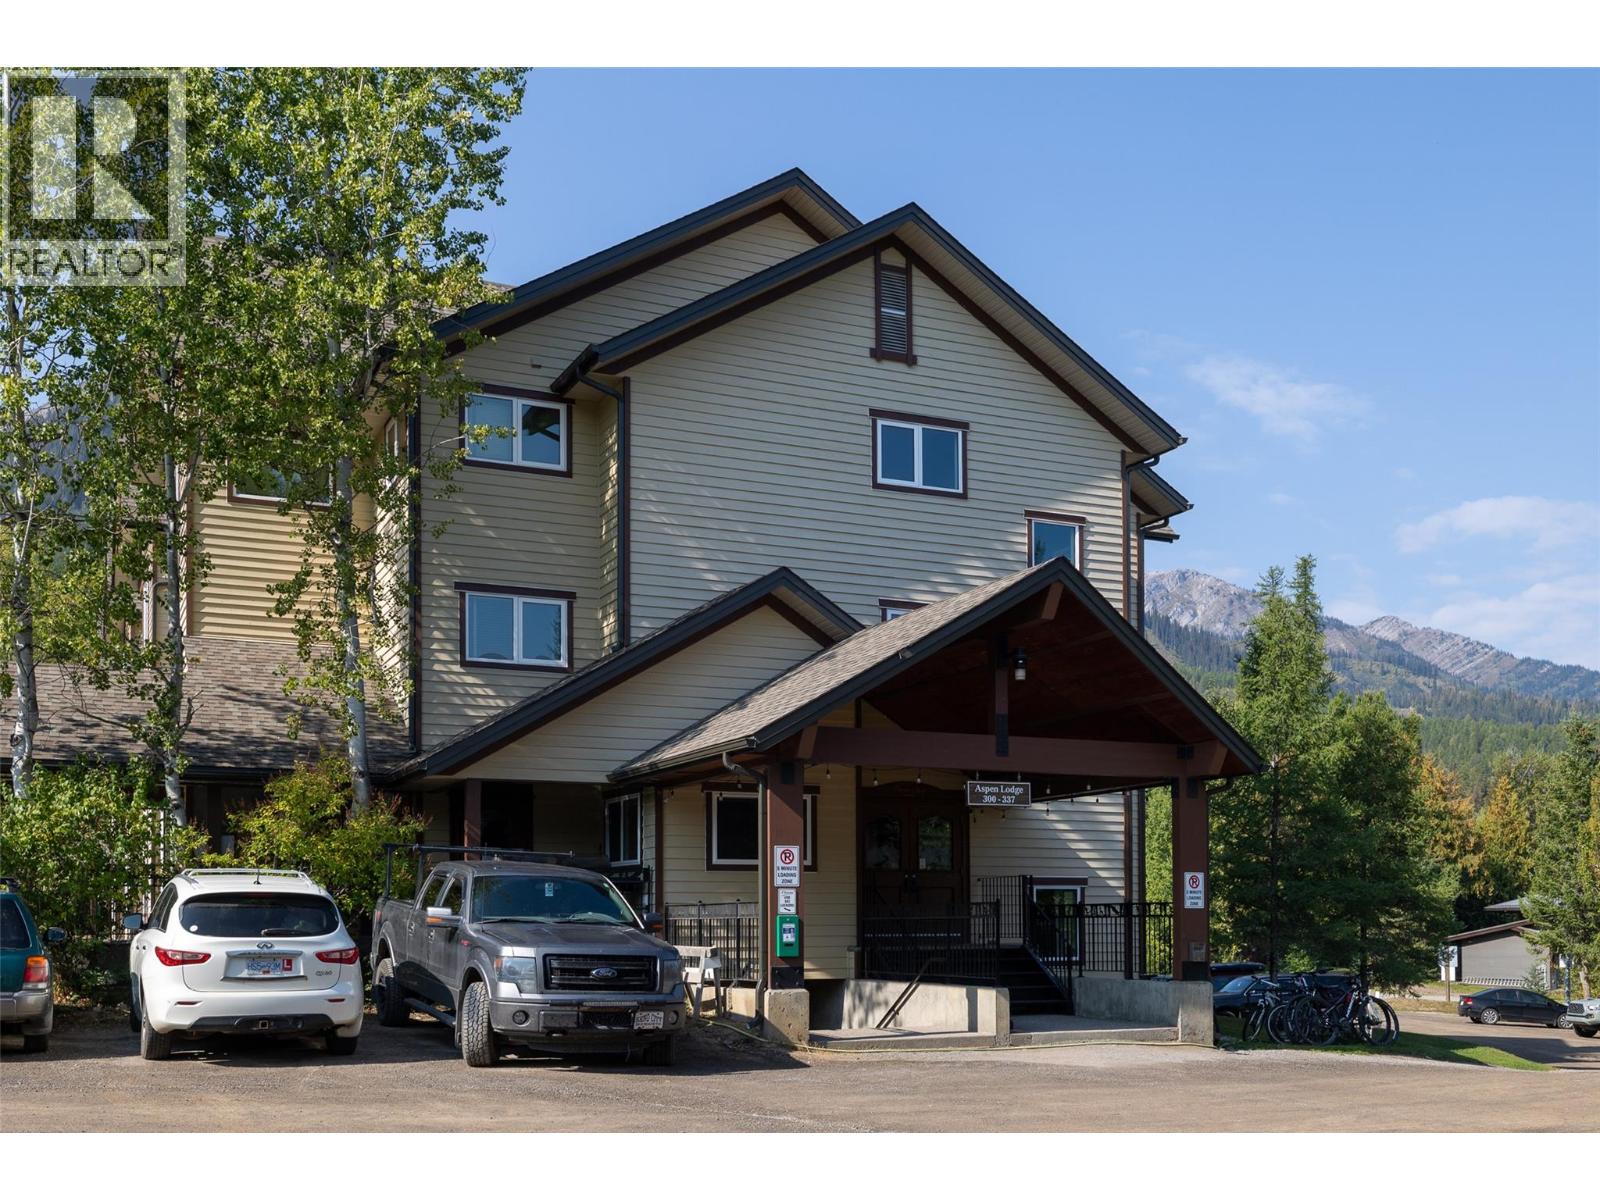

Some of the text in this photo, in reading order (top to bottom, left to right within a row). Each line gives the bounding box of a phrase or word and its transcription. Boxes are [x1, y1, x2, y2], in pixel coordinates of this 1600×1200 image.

[974, 784, 1024, 795] Aspen Lodge
[982, 795, 997, 803] 300
[1002, 795, 1016, 803] 337
